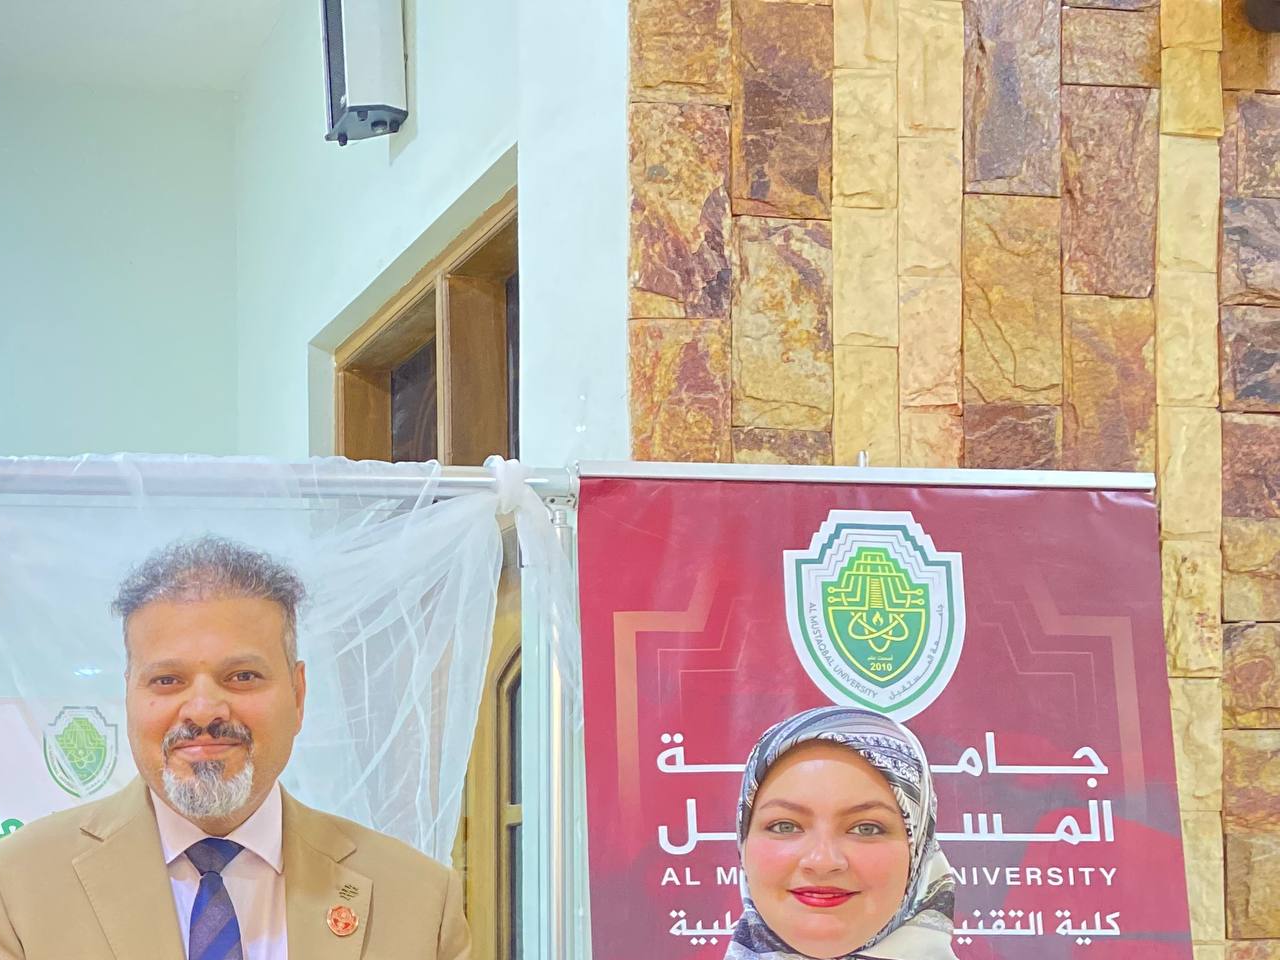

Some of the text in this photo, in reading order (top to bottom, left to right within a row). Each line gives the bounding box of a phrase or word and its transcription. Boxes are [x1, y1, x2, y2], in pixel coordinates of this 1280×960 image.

[809, 615, 834, 667] MUSTAQBAL
[833, 664, 879, 699] UNIVERSITY
[870, 662, 893, 671] 2010
[661, 867, 701, 886] AL
[953, 867, 1118, 887] NIVERSITY
[1054, 910, 1121, 945] كلية
